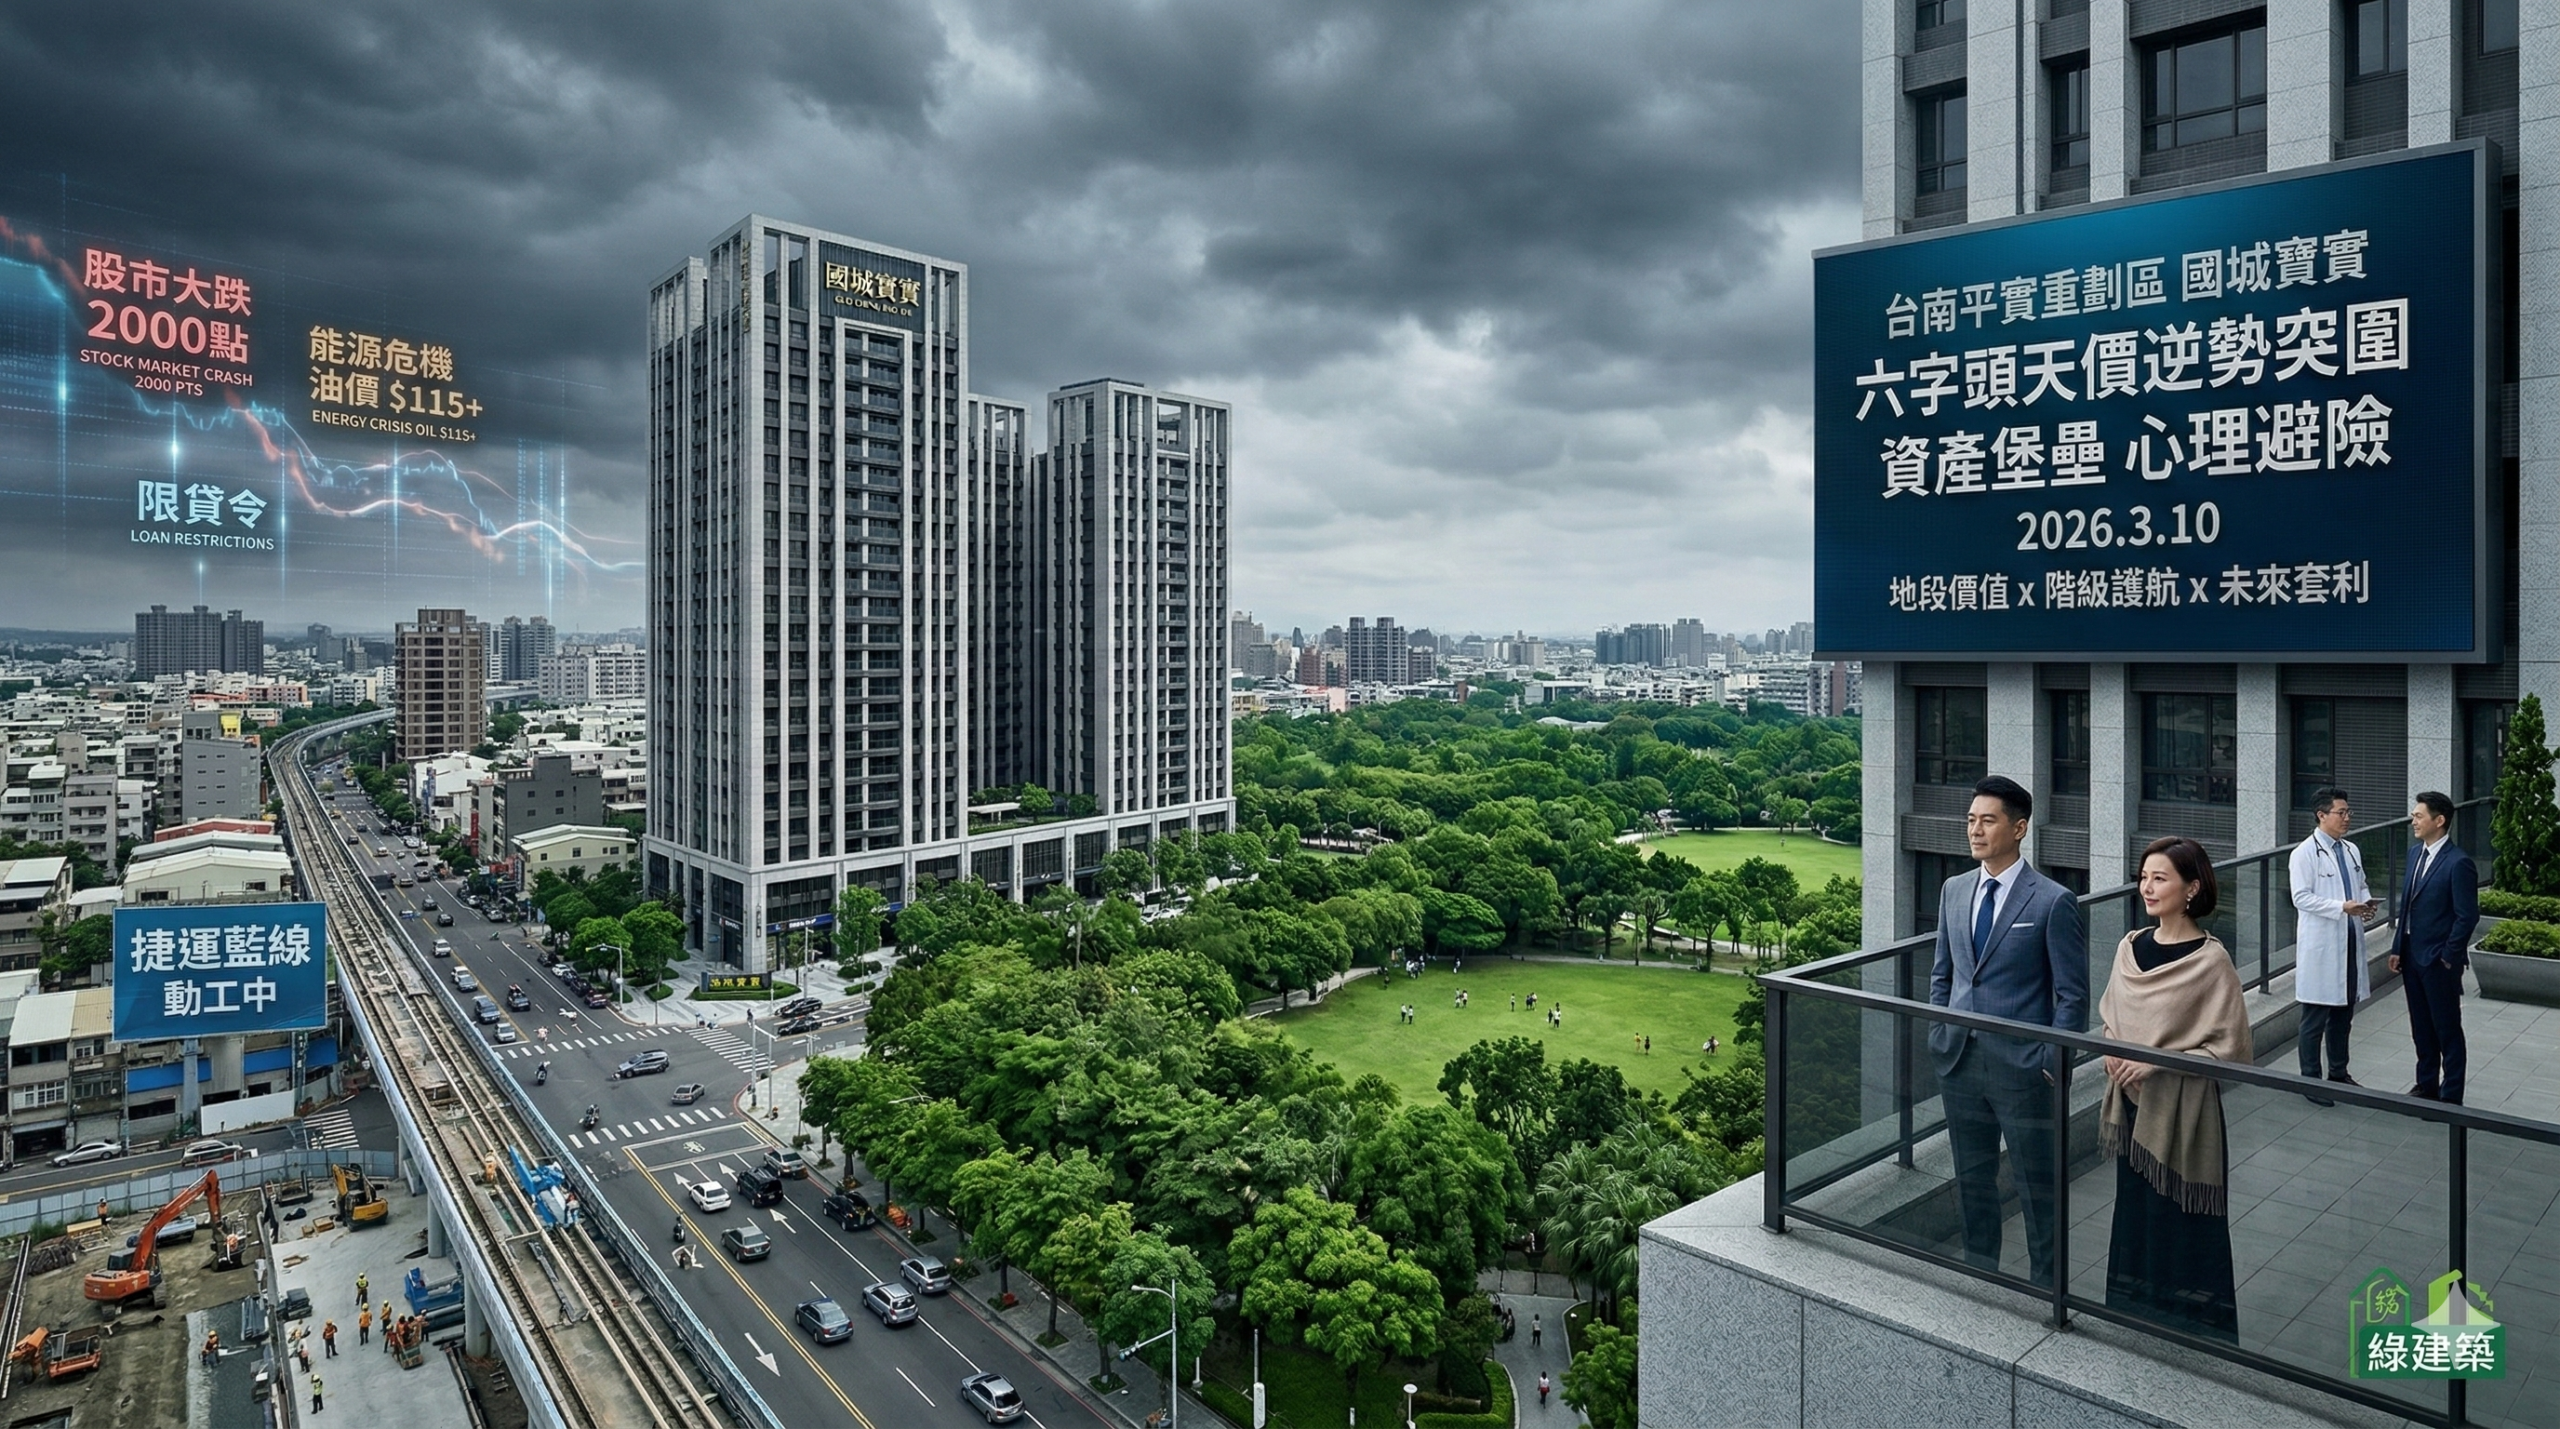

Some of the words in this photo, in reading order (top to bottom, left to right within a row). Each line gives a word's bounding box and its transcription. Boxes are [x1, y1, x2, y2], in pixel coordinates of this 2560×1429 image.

[1885, 255, 2167, 340] 台南平實重劃區
[2182, 228, 2369, 303] 國城寶實
[1855, 297, 2409, 422] 六字頭天價逆勢突圍
[1880, 420, 2107, 500] 資產堡壘
[2125, 394, 2393, 481] 心理避險
[2016, 501, 2221, 551] 2026.3.10
[1889, 572, 2010, 612] 地段價值
[2045, 566, 2181, 609] 階級護航
[2218, 560, 2370, 608] 未來套利
[130, 923, 312, 974] 捷運藍線
[163, 975, 277, 1017] 動工中
